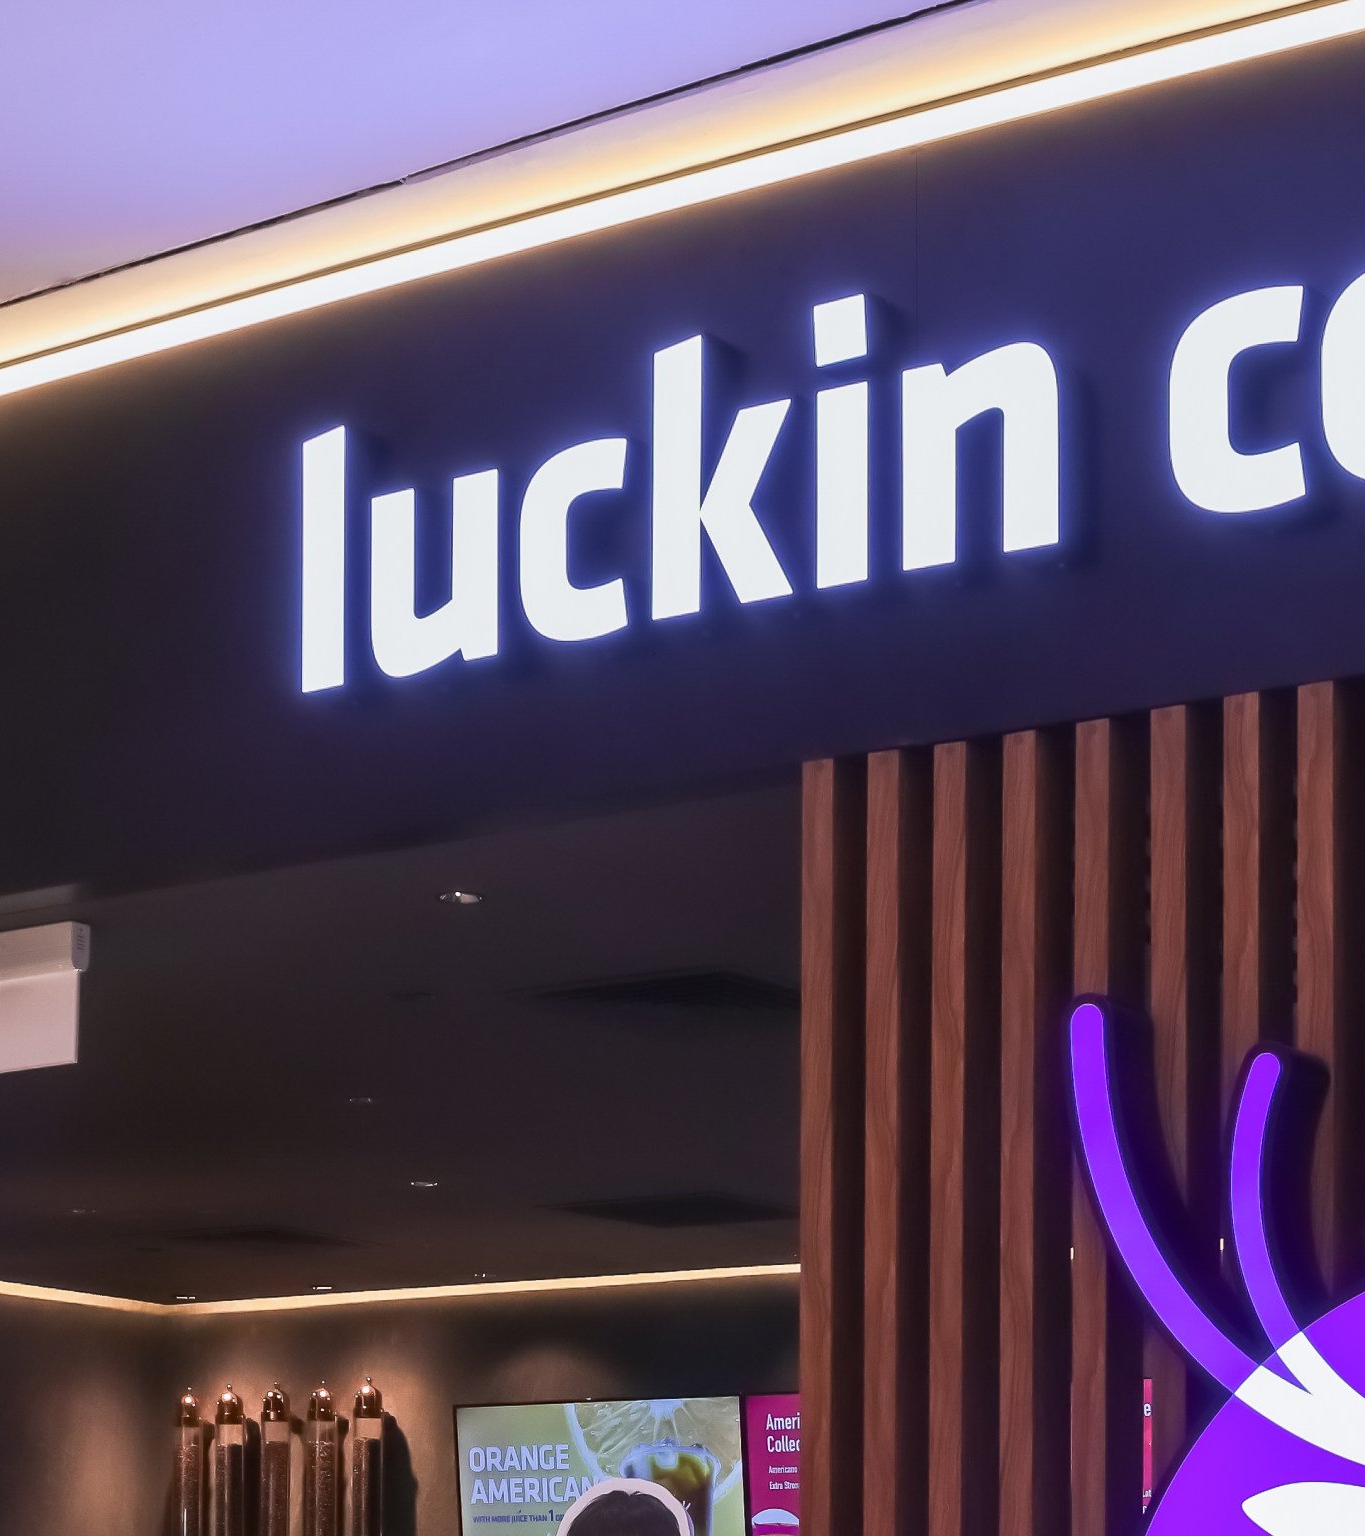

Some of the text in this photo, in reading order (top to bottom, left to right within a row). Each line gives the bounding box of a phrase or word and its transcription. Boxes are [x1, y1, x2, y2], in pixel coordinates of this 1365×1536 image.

[301, 293, 1059, 694] luckin
[766, 1412, 800, 1430] Ameri
[767, 1435, 800, 1452] Collec
[469, 1444, 569, 1472] ORANGE
[471, 1476, 592, 1504] AMERICA
[769, 1481, 800, 1490] Extra Stron
[491, 1515, 511, 1523] MORE
[529, 1514, 547, 1522] THAN
[548, 1509, 554, 1522] 1
